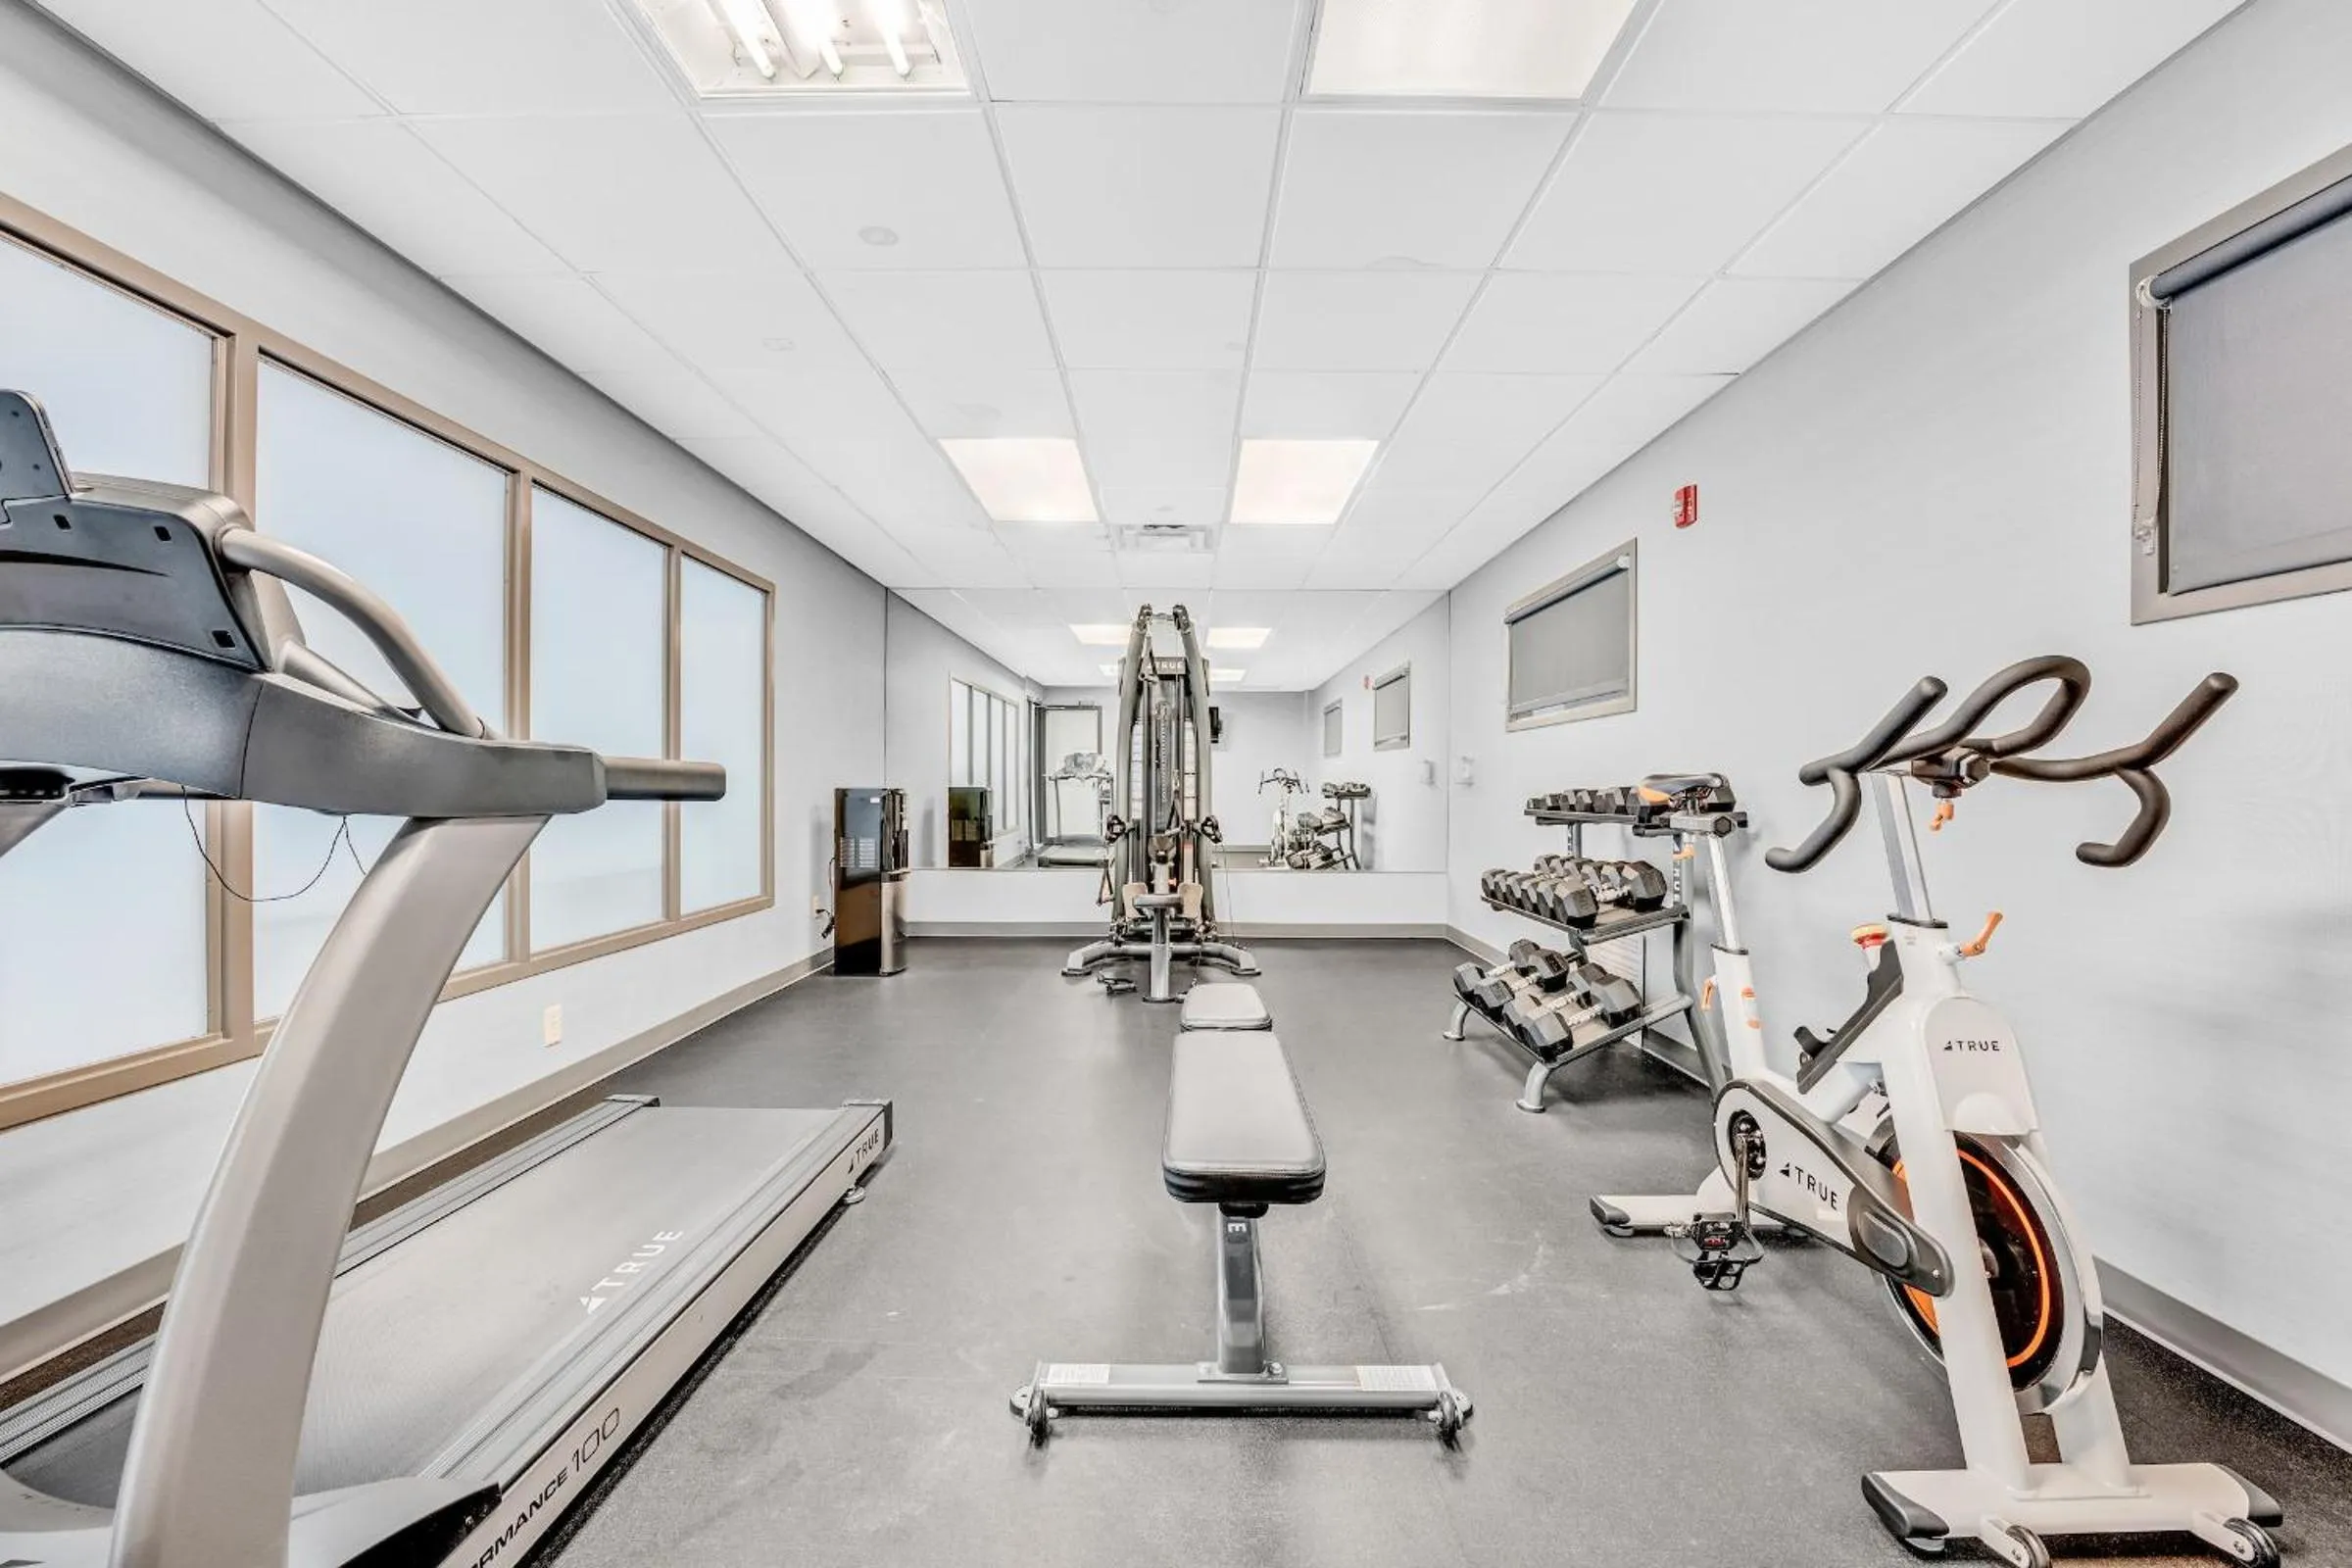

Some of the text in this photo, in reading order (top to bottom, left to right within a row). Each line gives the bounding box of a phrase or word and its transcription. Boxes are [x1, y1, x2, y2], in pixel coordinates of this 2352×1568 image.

[1955, 1041, 2000, 1052] TRUE
[856, 1128, 879, 1164] TRUE
[1794, 1165, 1838, 1210] TRUE
[591, 1231, 683, 1292] TRUE
[471, 1407, 620, 1568] RMANCE 100
